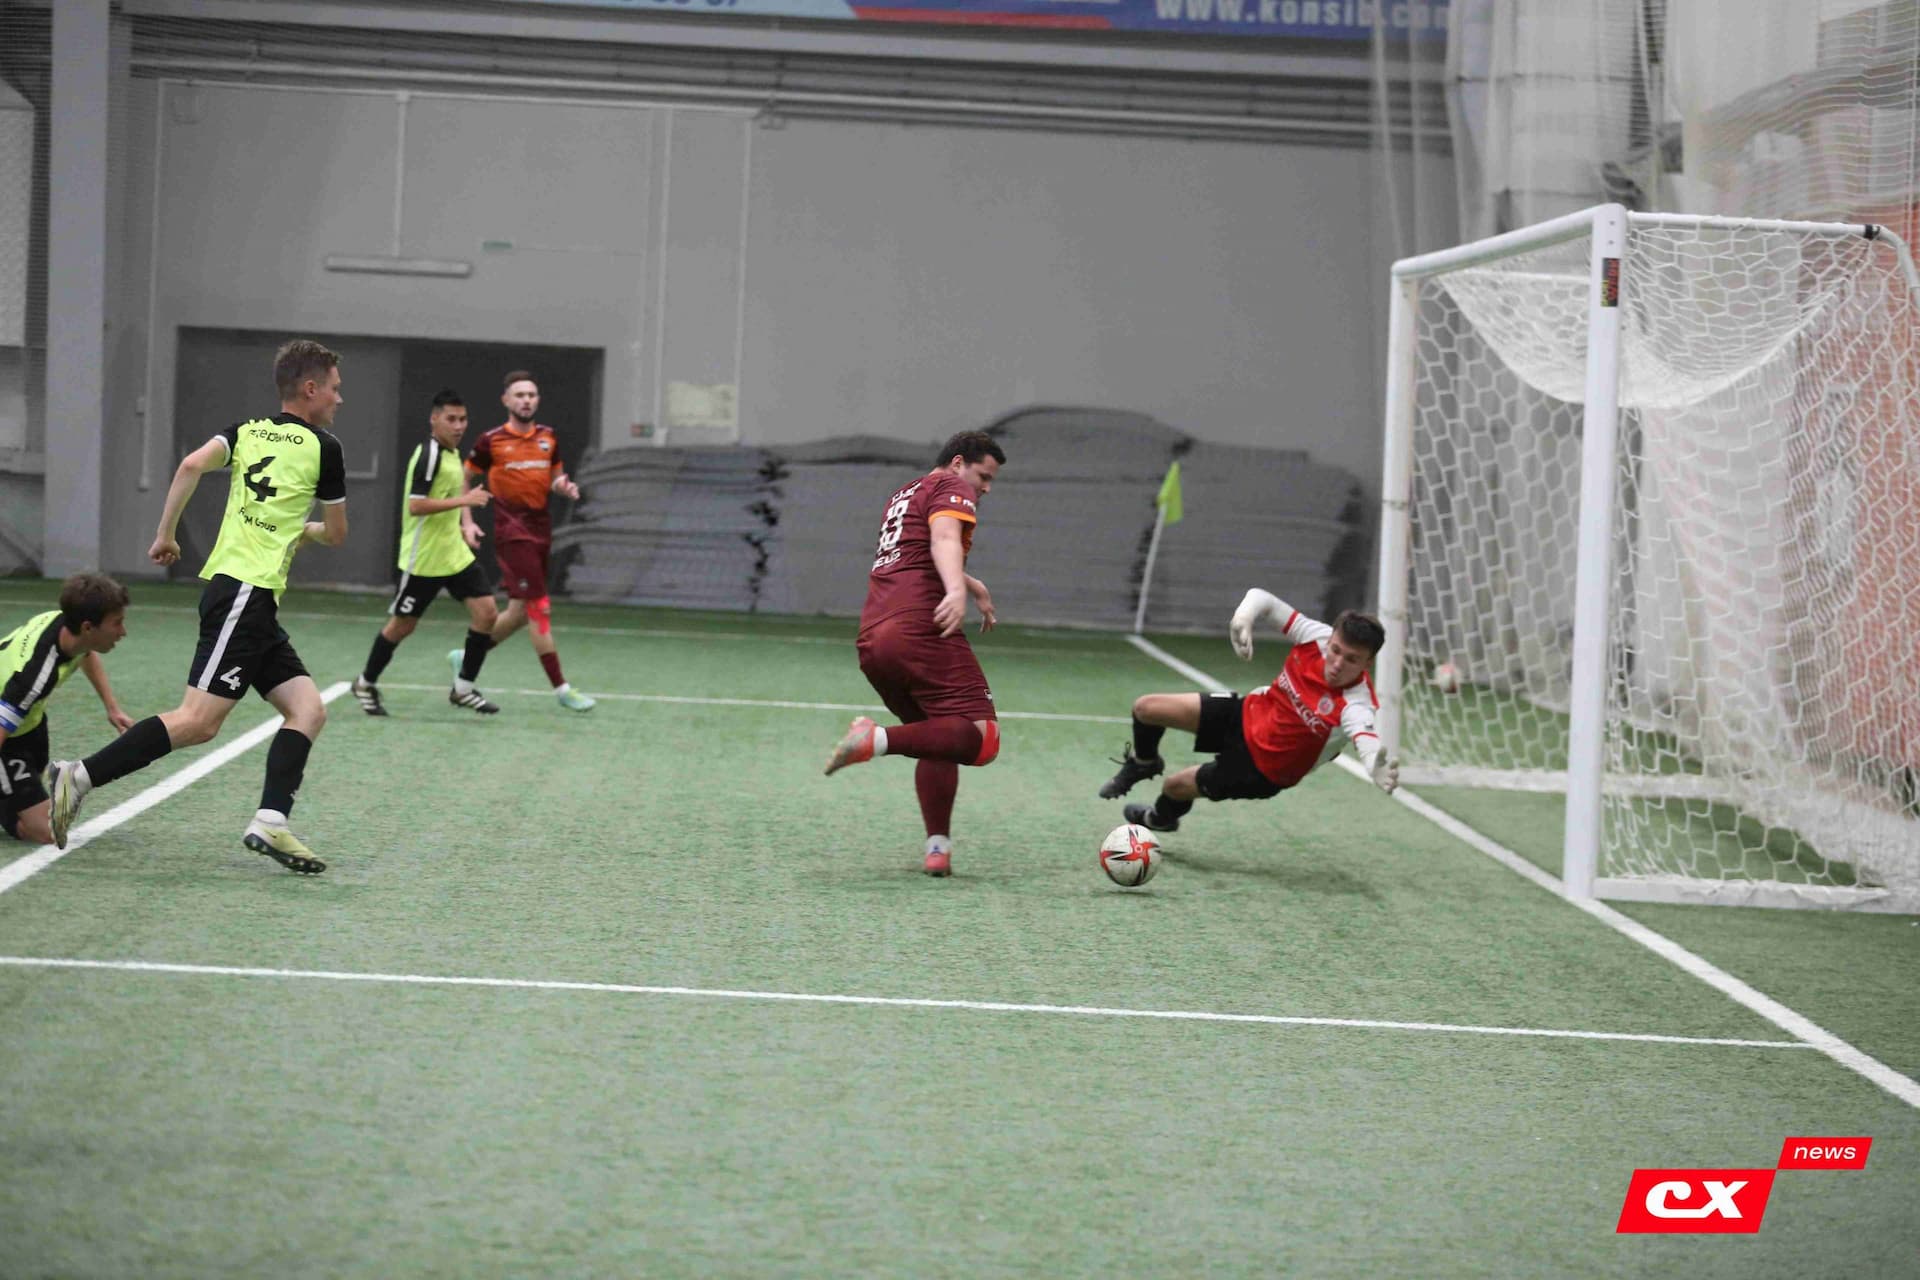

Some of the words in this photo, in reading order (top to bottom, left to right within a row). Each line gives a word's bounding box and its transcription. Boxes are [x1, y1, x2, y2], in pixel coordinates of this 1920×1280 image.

[243, 455, 278, 503] 4
[399, 595, 416, 613] 5
[220, 666, 242, 691] 4
[8, 758, 32, 781] 2
